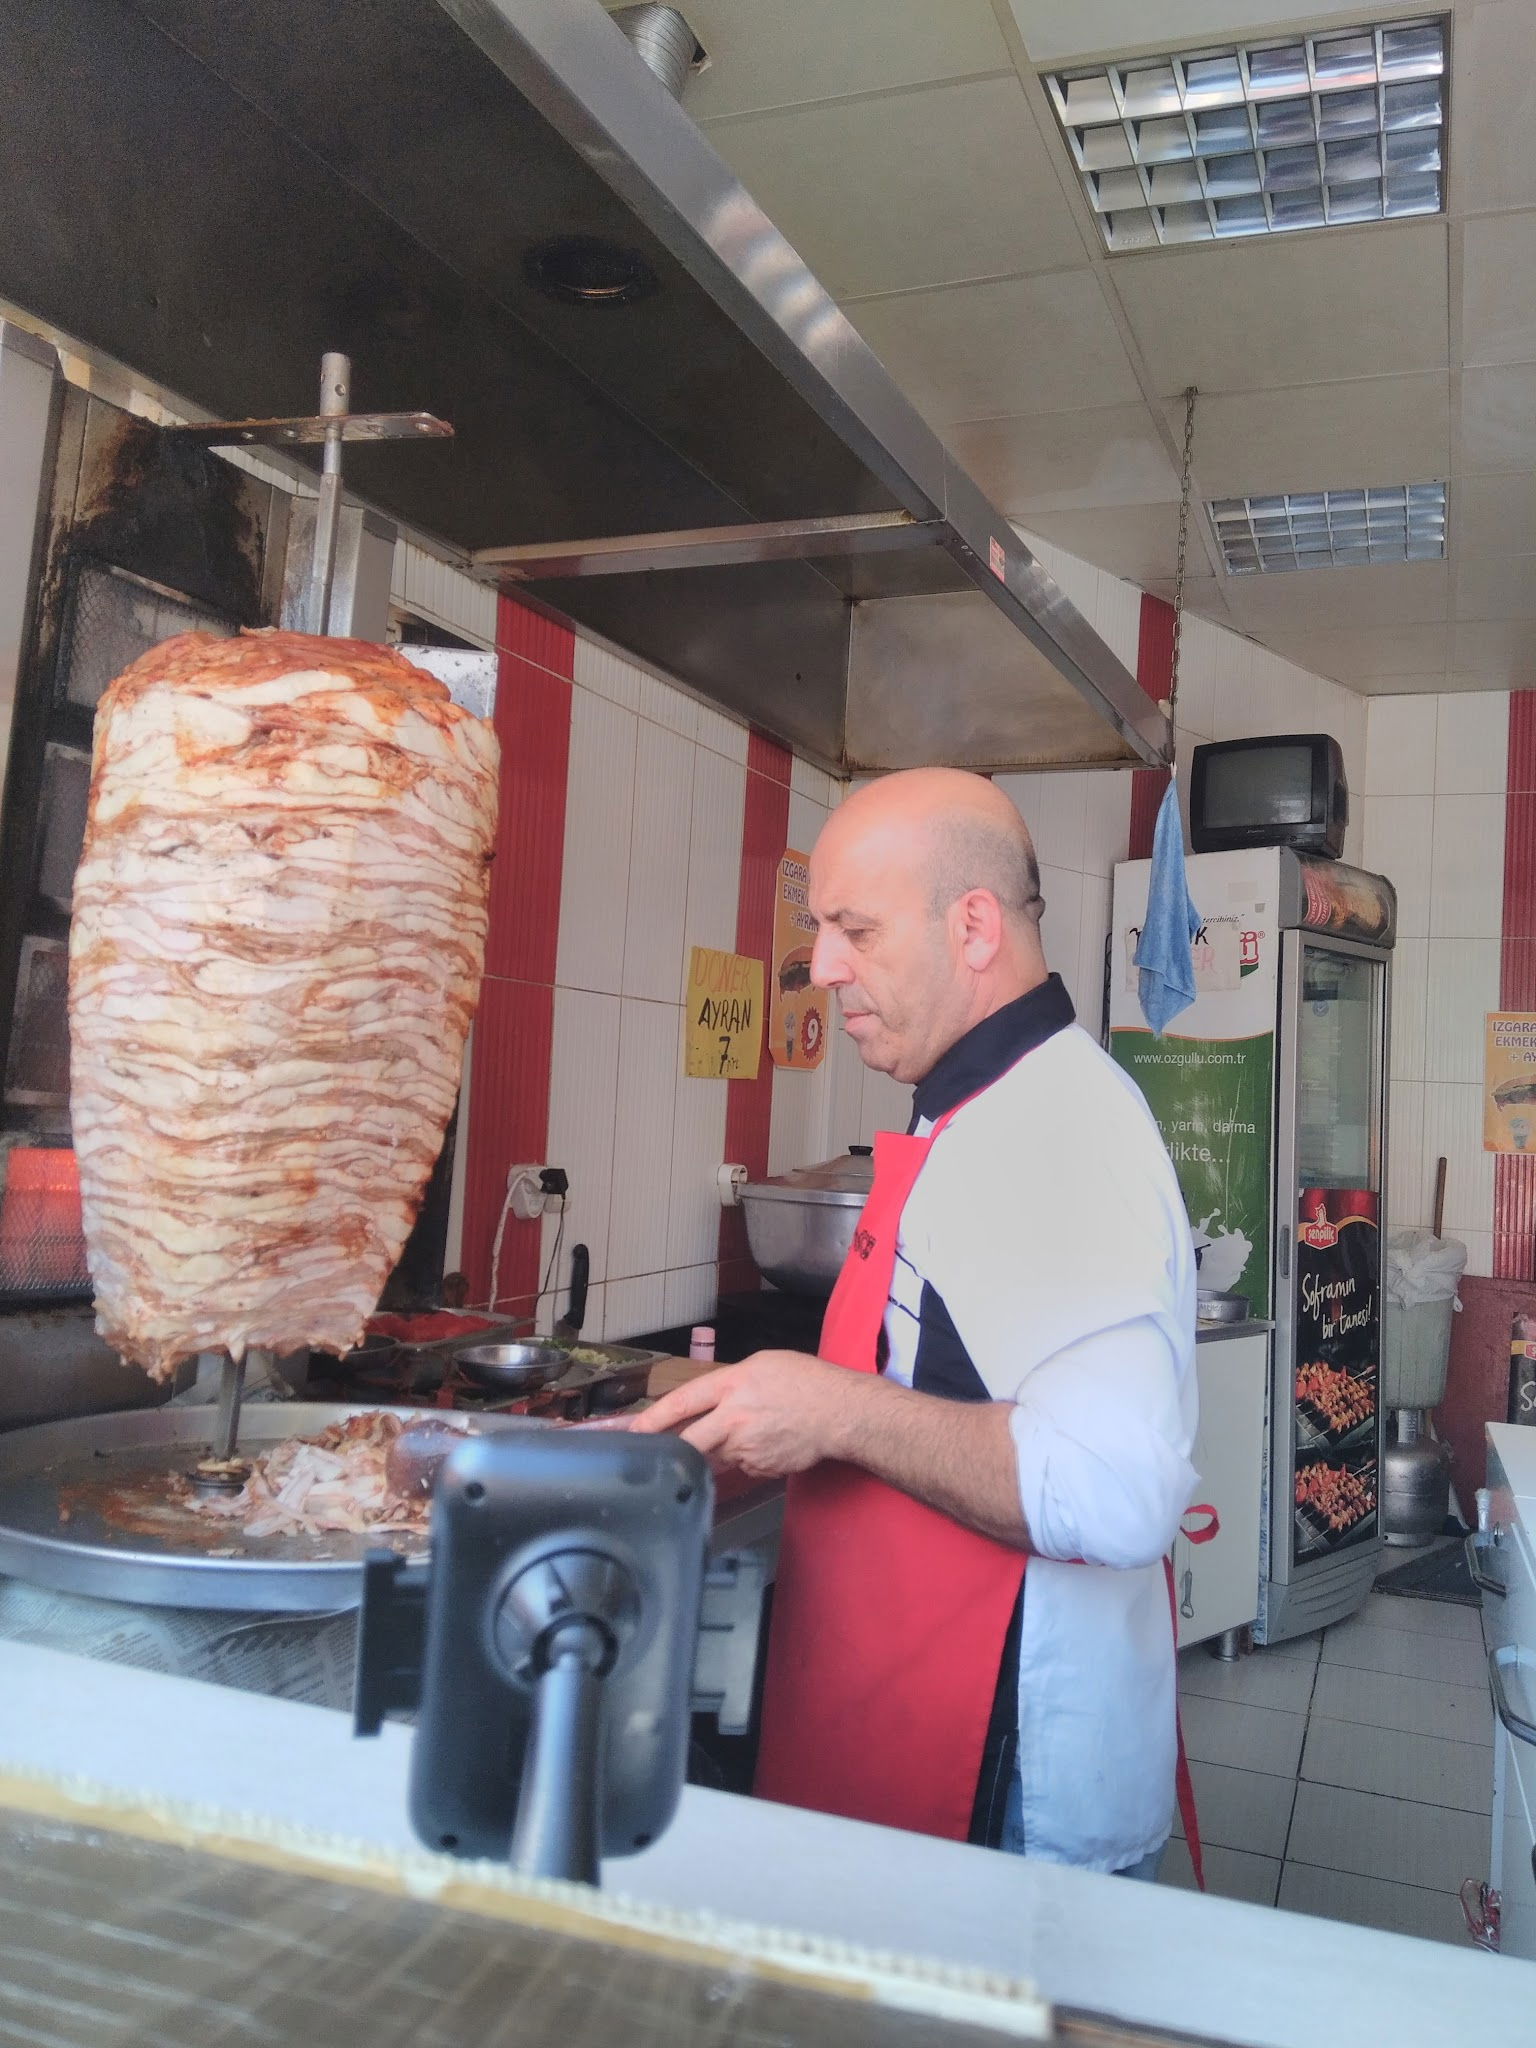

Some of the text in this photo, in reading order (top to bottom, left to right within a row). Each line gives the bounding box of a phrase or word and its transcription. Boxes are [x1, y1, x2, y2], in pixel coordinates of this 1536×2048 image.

[698, 997, 752, 1034] AYRAN
[1492, 1021, 1536, 1032] IZGARA
[806, 1018, 819, 1050] 9
[1495, 1036, 1536, 1047] EKMEK
[719, 1036, 732, 1075] 7
[1133, 1052, 1247, 1067] www.ozgullu.com.tr
[1212, 1119, 1256, 1134] daima
[1302, 1272, 1356, 1321] Soframın
[1322, 1294, 1372, 1340] bir tanesi!
